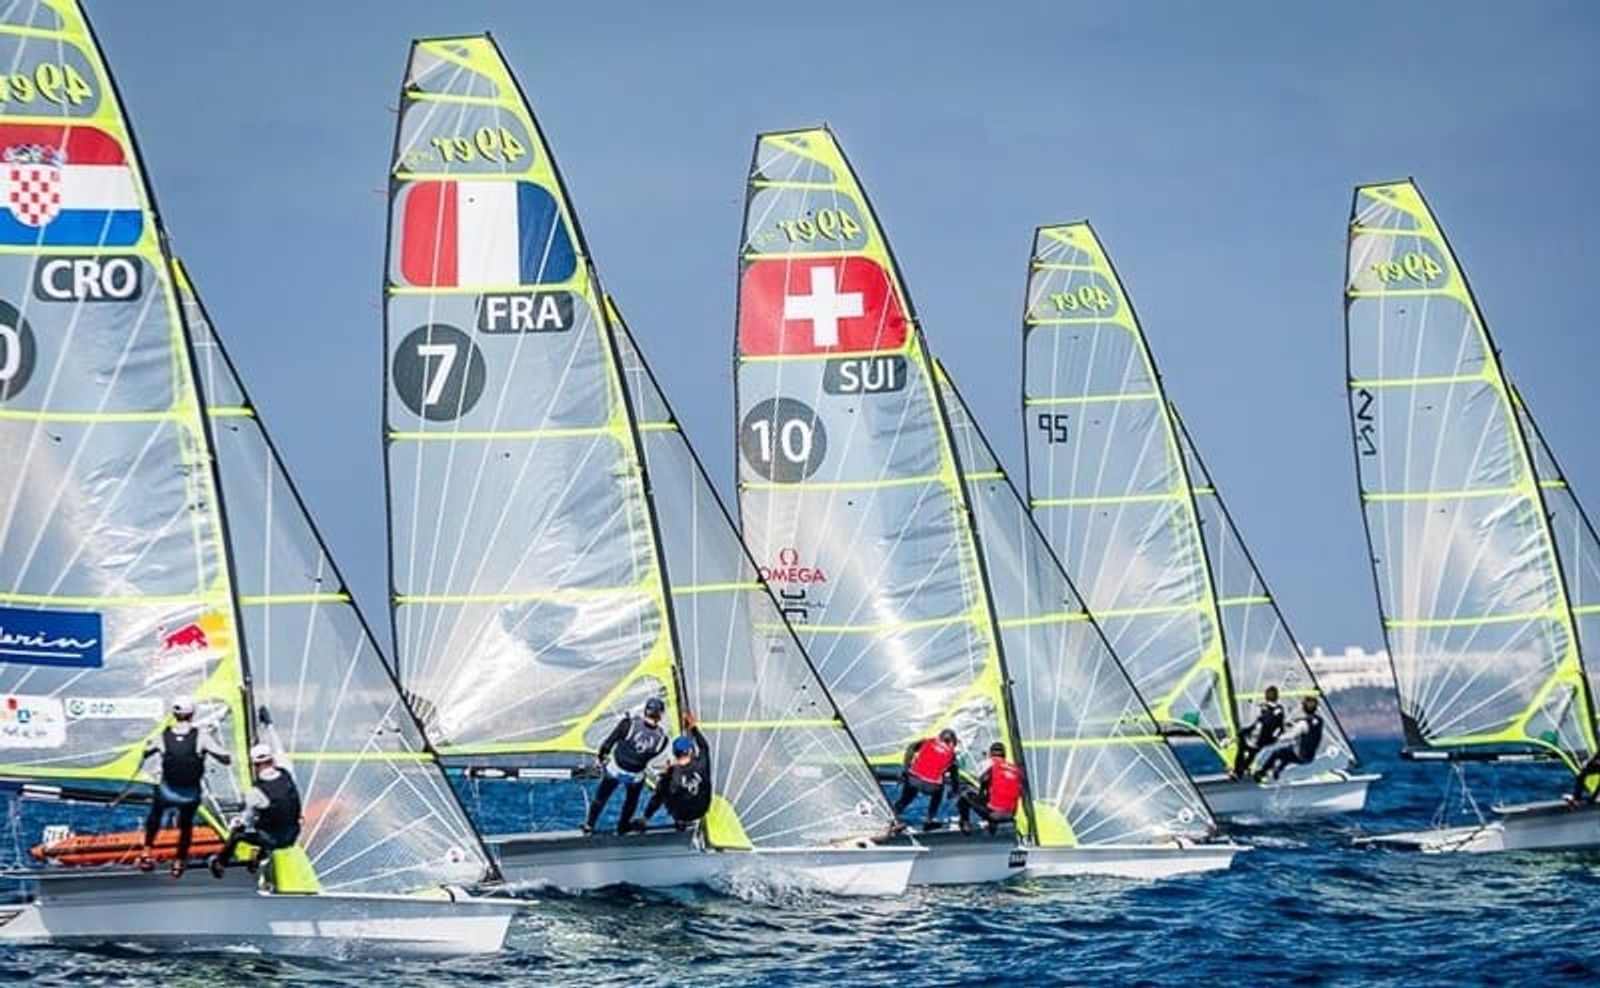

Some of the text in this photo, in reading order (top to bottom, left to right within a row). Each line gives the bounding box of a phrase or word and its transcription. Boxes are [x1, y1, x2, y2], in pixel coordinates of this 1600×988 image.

[41, 259, 137, 298] CRO
[486, 296, 564, 330] FRA
[417, 344, 457, 405] 7
[839, 359, 896, 391] SUI
[751, 419, 814, 463] 10
[1038, 413, 1069, 444] 95
[760, 566, 826, 582] OMEGA
